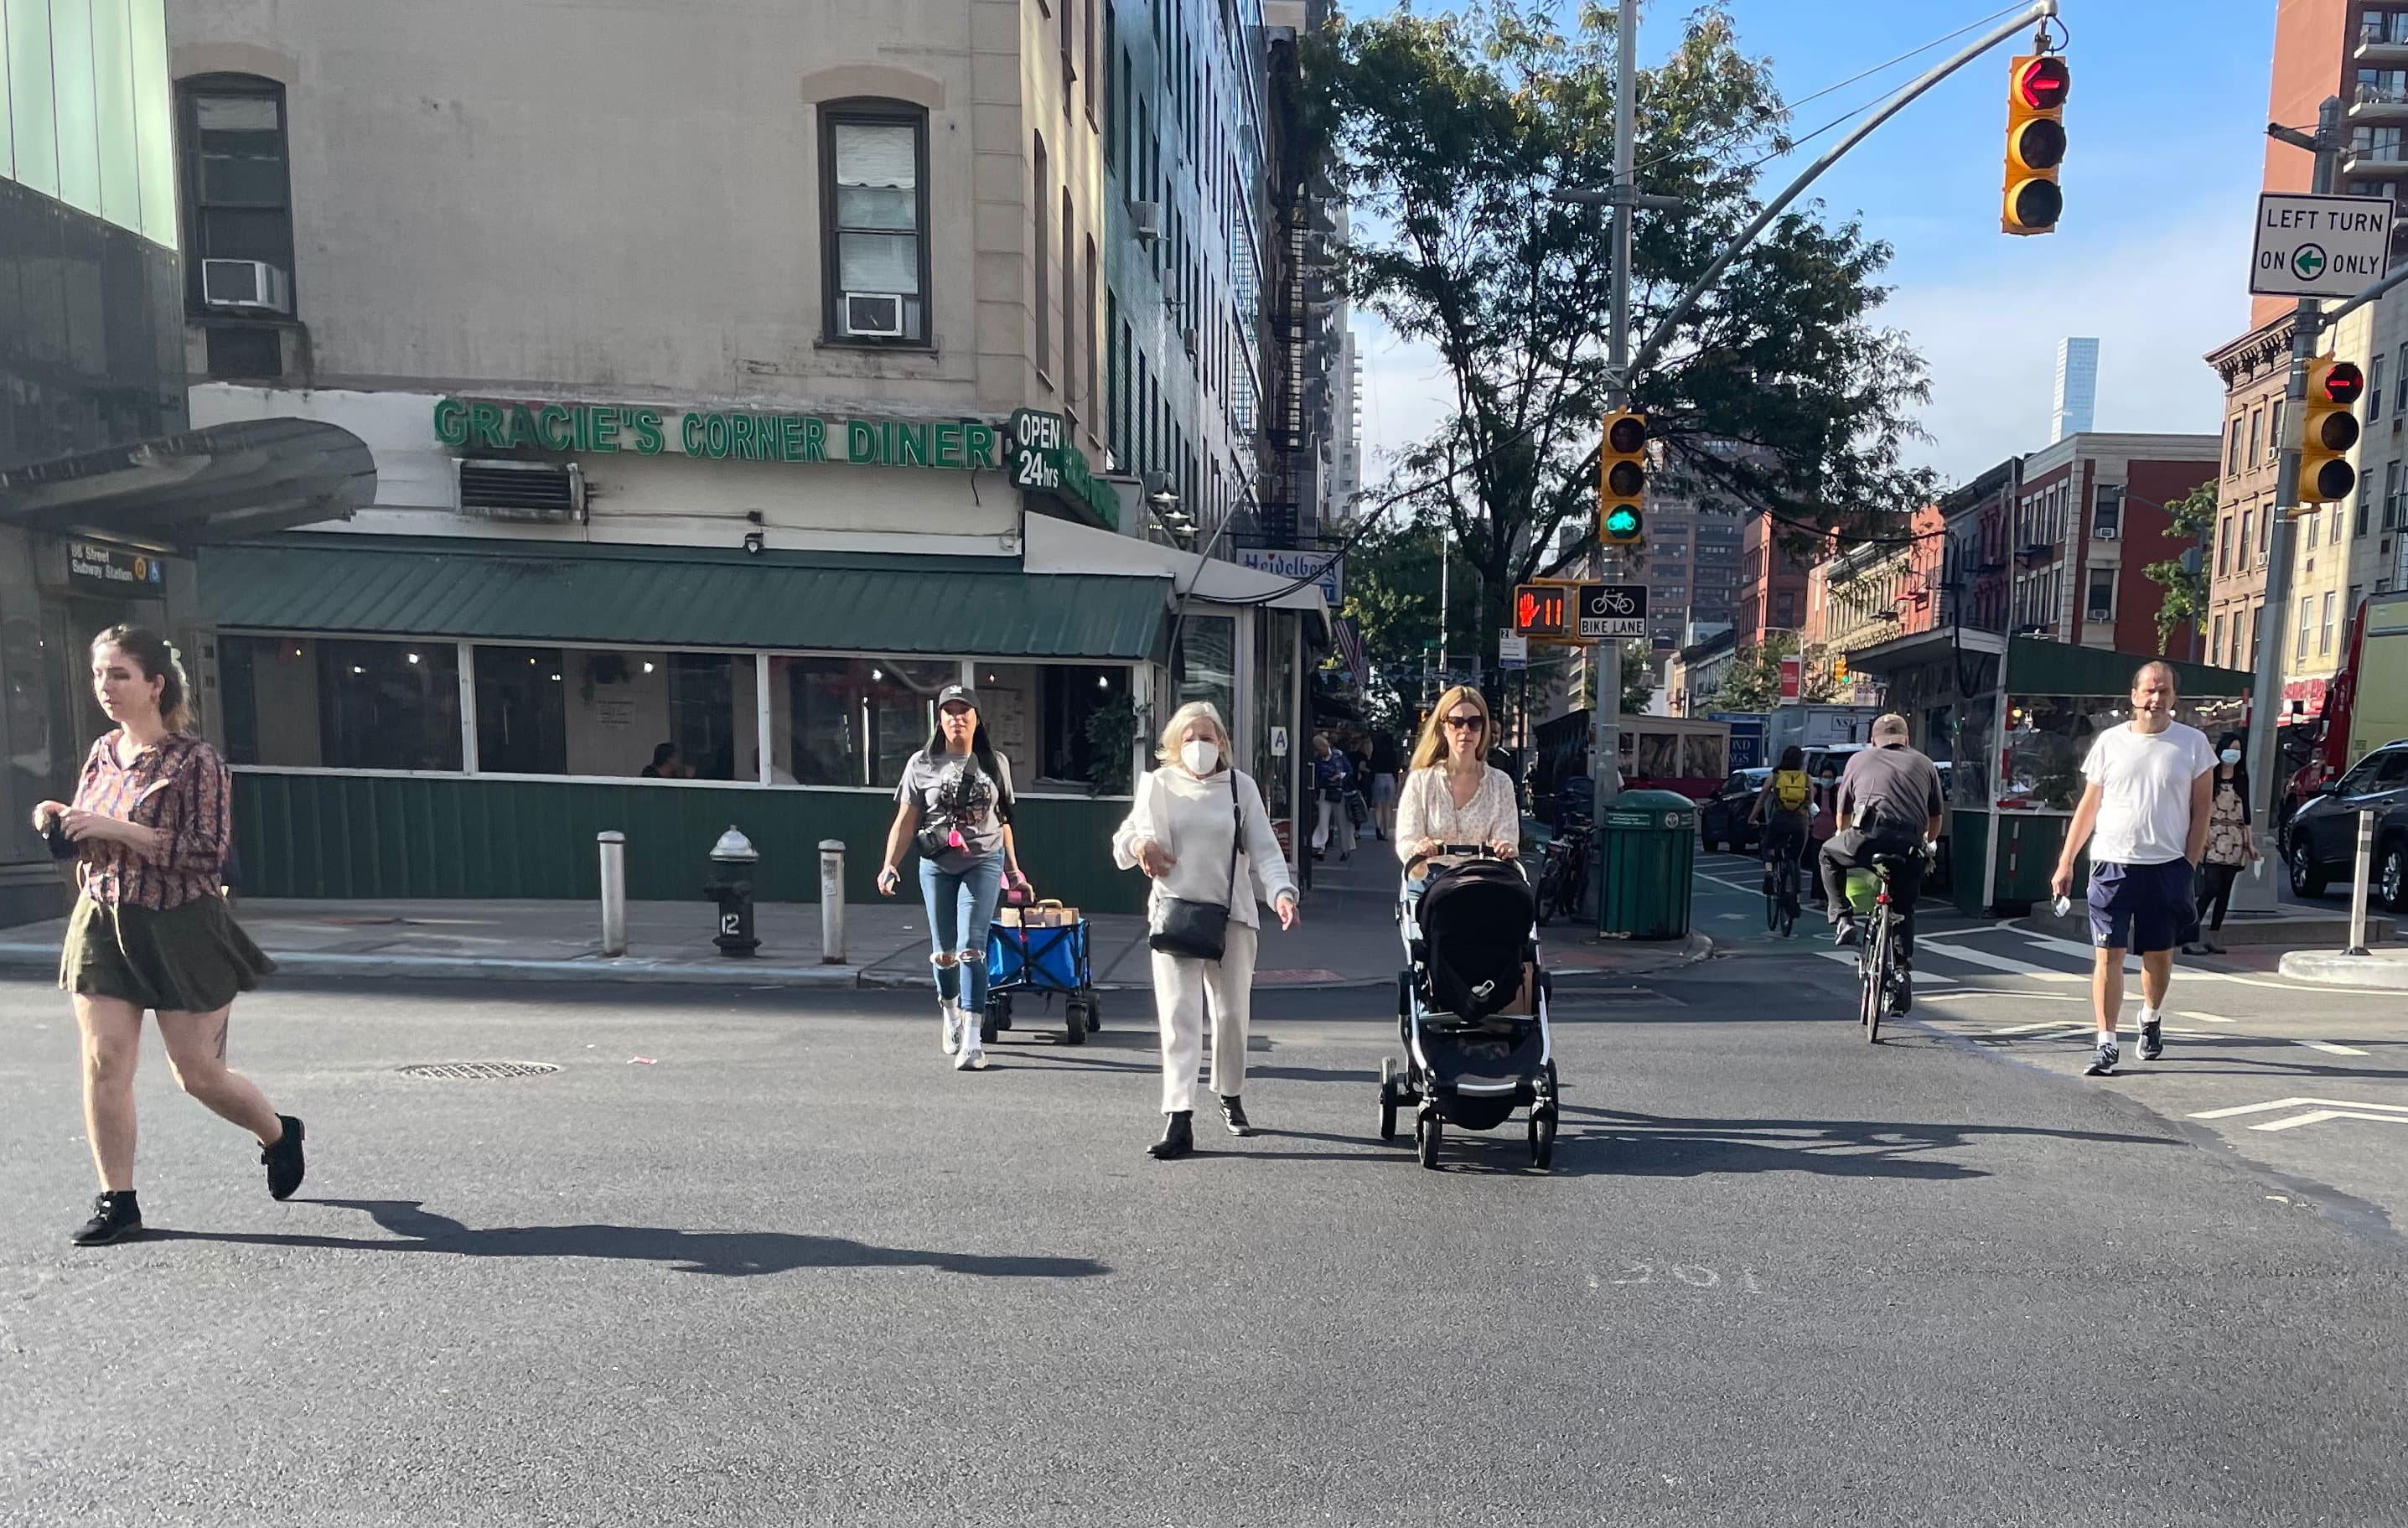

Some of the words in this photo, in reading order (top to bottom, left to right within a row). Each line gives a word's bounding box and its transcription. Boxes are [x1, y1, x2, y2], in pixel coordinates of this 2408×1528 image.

[2266, 209, 2319, 230] LEFT
[2328, 211, 2383, 232] TURN
[2260, 251, 2286, 270] ON
[2333, 254, 2380, 275] ONLY
[434, 399, 665, 455] GRACIE'S
[681, 412, 827, 464] CORNER
[847, 419, 997, 471] DINER
[1019, 413, 1061, 450] OPEN
[85, 546, 109, 563] Street
[72, 559, 102, 579] Subway
[106, 564, 133, 581] Station
[1582, 620, 1608, 634] BIKE
[1613, 620, 1644, 634] LANE
[1275, 730, 1286, 748] A
[722, 914, 739, 935] 12
